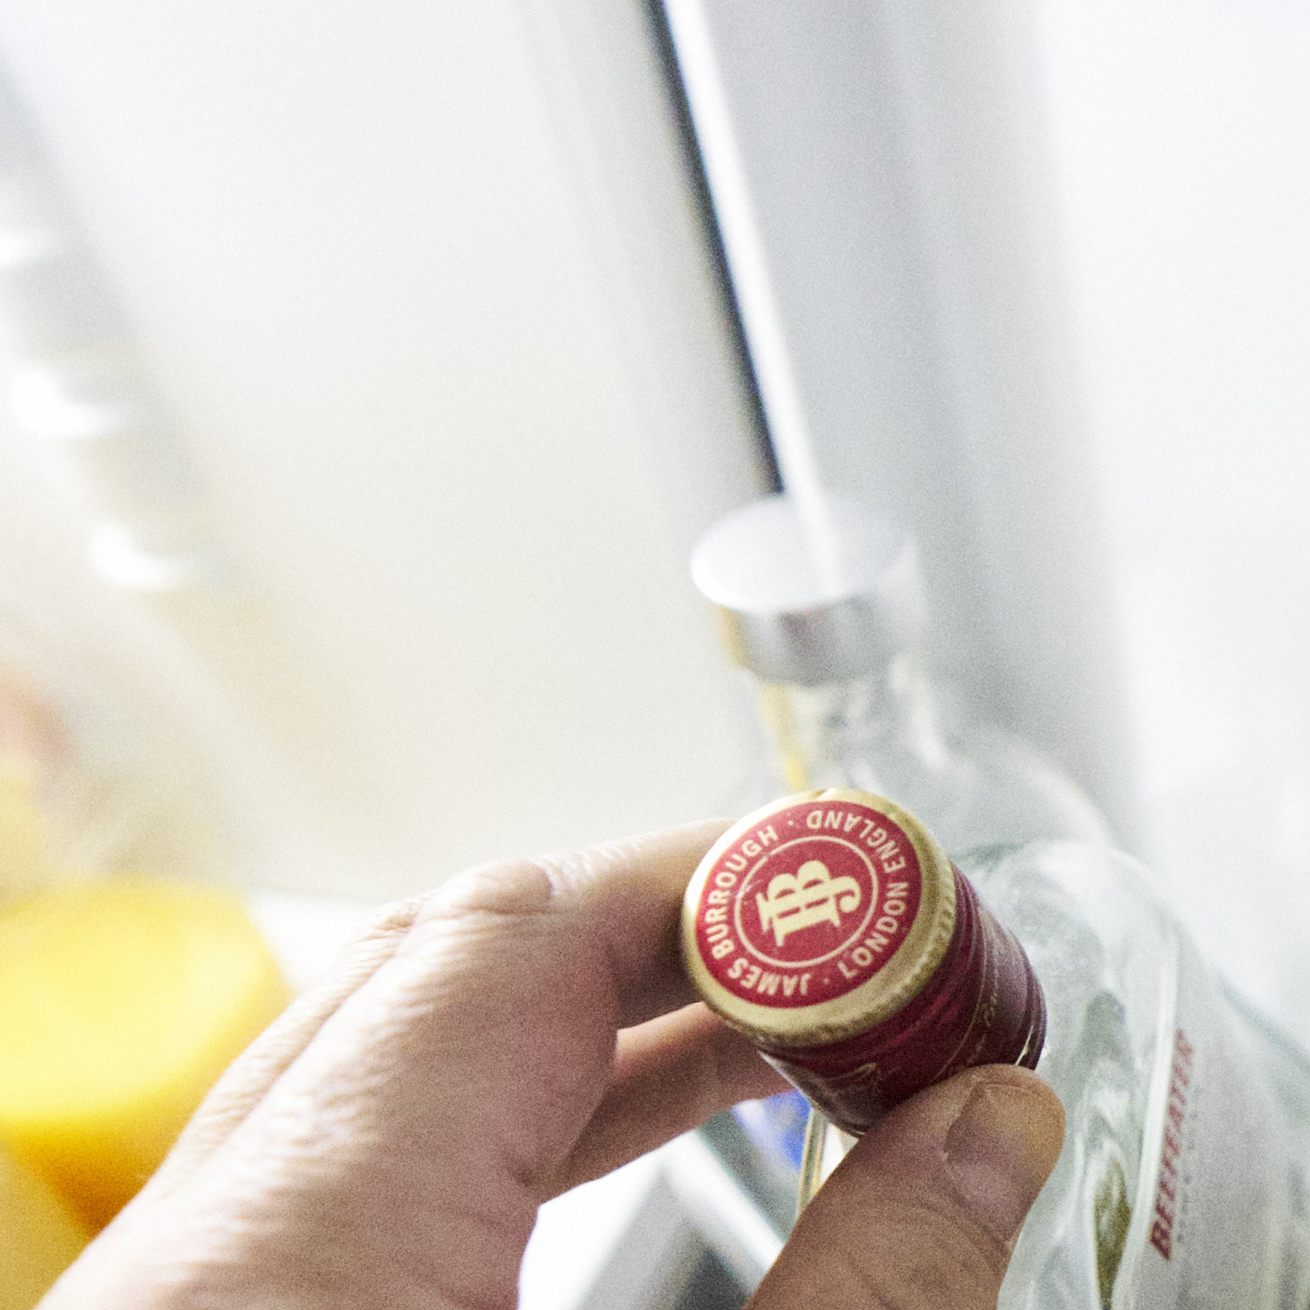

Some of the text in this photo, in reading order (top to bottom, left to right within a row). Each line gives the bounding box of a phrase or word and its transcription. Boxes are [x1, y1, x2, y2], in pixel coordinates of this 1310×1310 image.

[806, 809, 907, 873] ENGLAND
[704, 825, 812, 996] JAMES BURROUGH
[837, 882, 909, 979] LONDON
